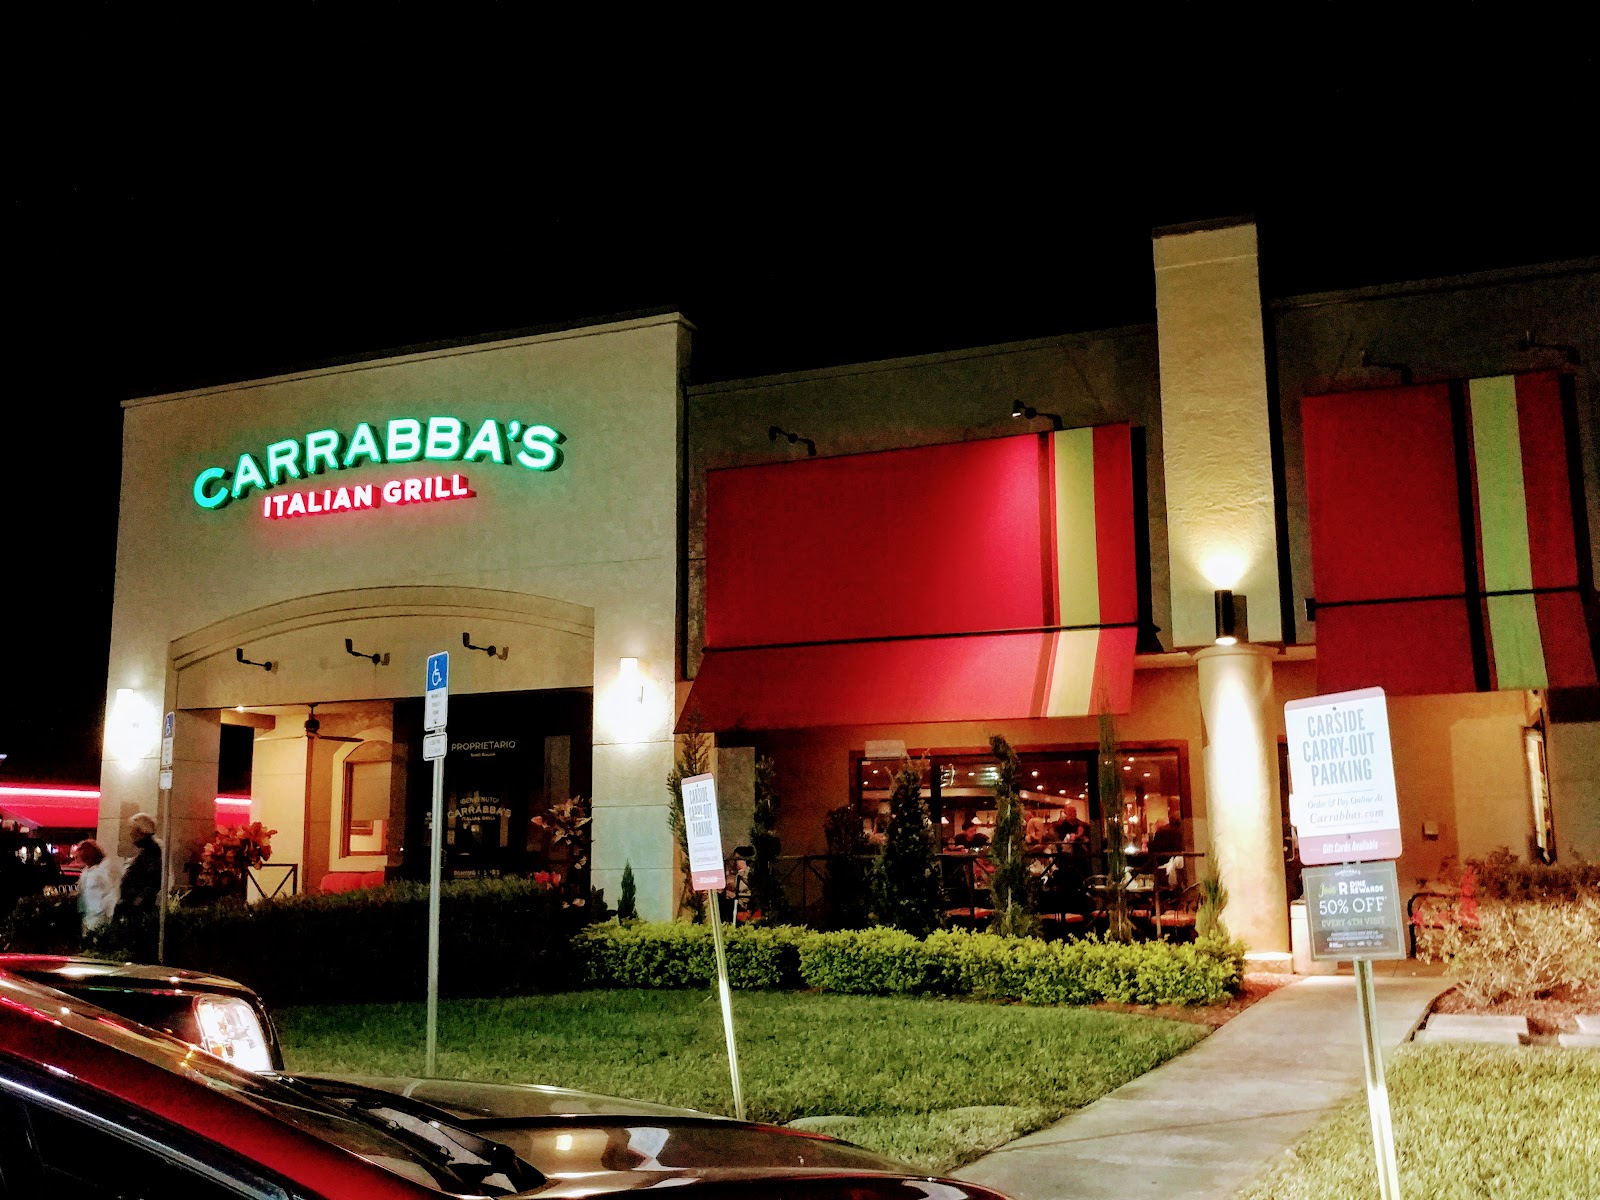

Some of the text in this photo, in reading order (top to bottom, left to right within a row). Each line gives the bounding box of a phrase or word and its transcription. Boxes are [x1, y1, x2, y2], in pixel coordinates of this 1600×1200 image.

[193, 417, 565, 509] CARRABBA'S
[263, 474, 473, 518] ITALIAN GRILL
[1307, 708, 1366, 738] CARSIDE
[451, 741, 516, 751] PROPRIETARIO
[1303, 732, 1375, 763] CARRY-OUT
[1311, 758, 1373, 786] PARKING
[1309, 809, 1384, 824] Carrabbas.com
[1319, 898, 1349, 915] 50%
